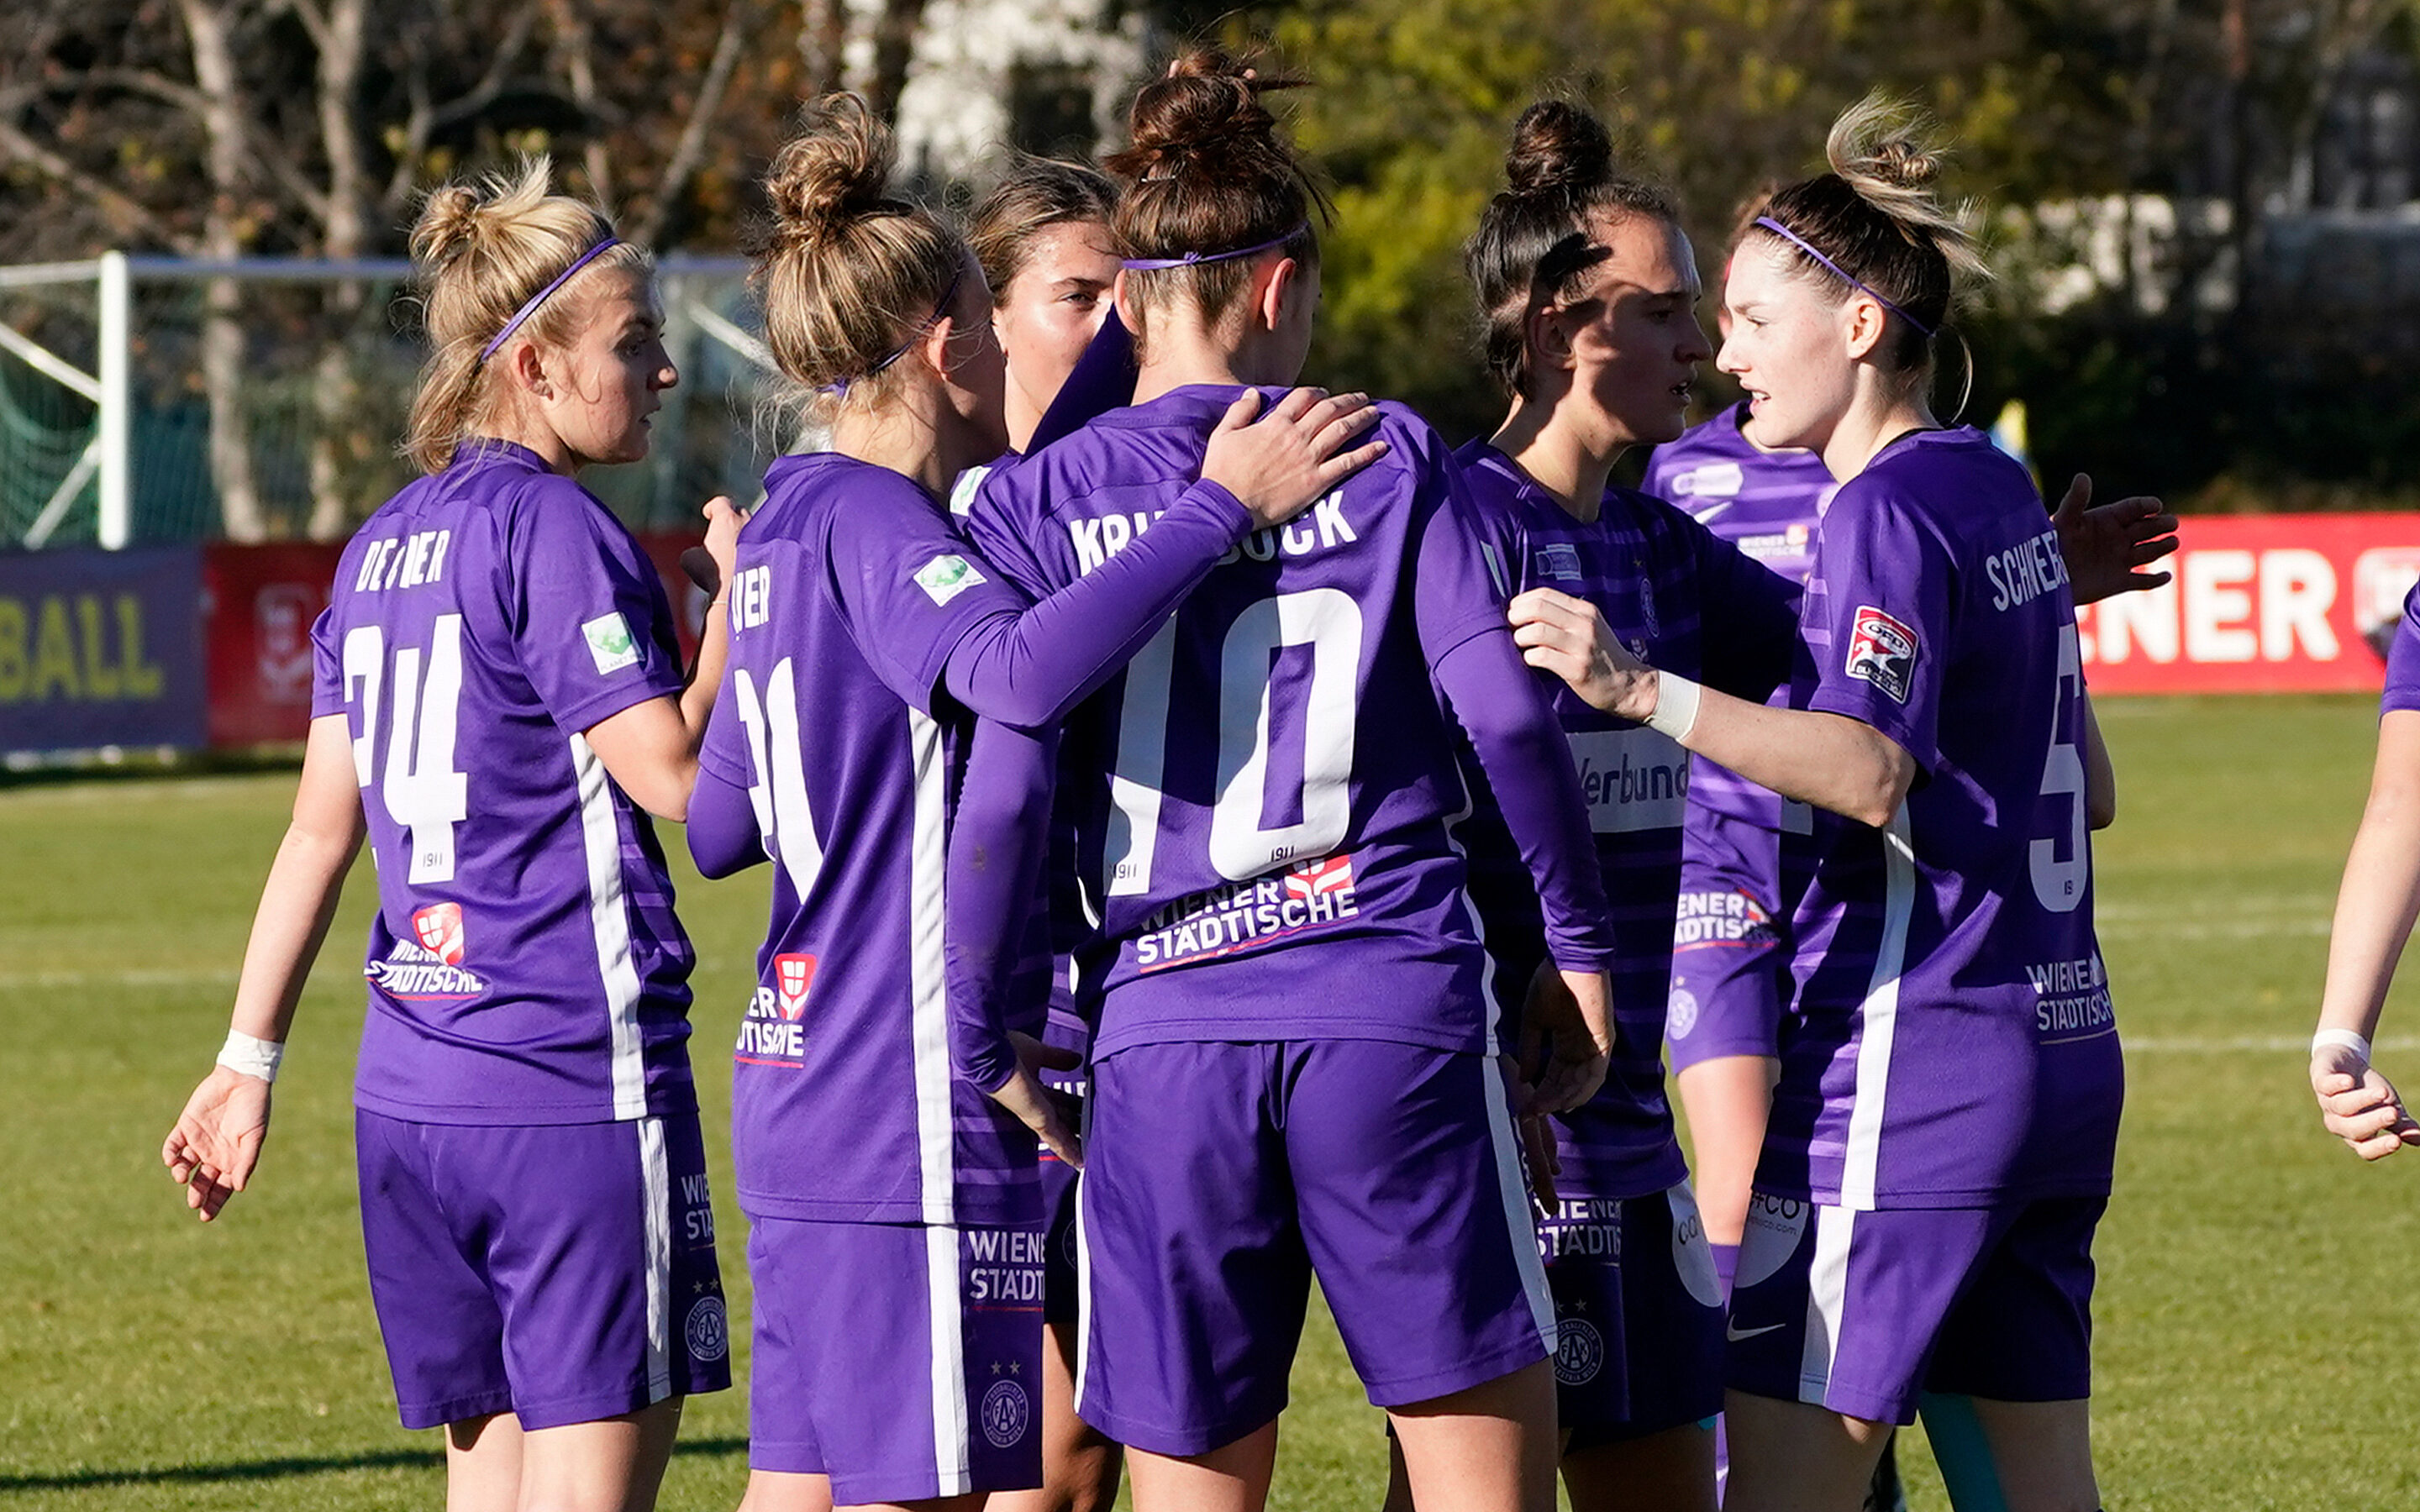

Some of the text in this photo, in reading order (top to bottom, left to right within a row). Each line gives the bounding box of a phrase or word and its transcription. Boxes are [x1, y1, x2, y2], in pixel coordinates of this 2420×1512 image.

[1103, 587, 1363, 896] 10
[423, 853, 443, 867] 1911
[1270, 845, 1295, 864] 1911
[1136, 886, 1360, 965] STÄDTISCHE
